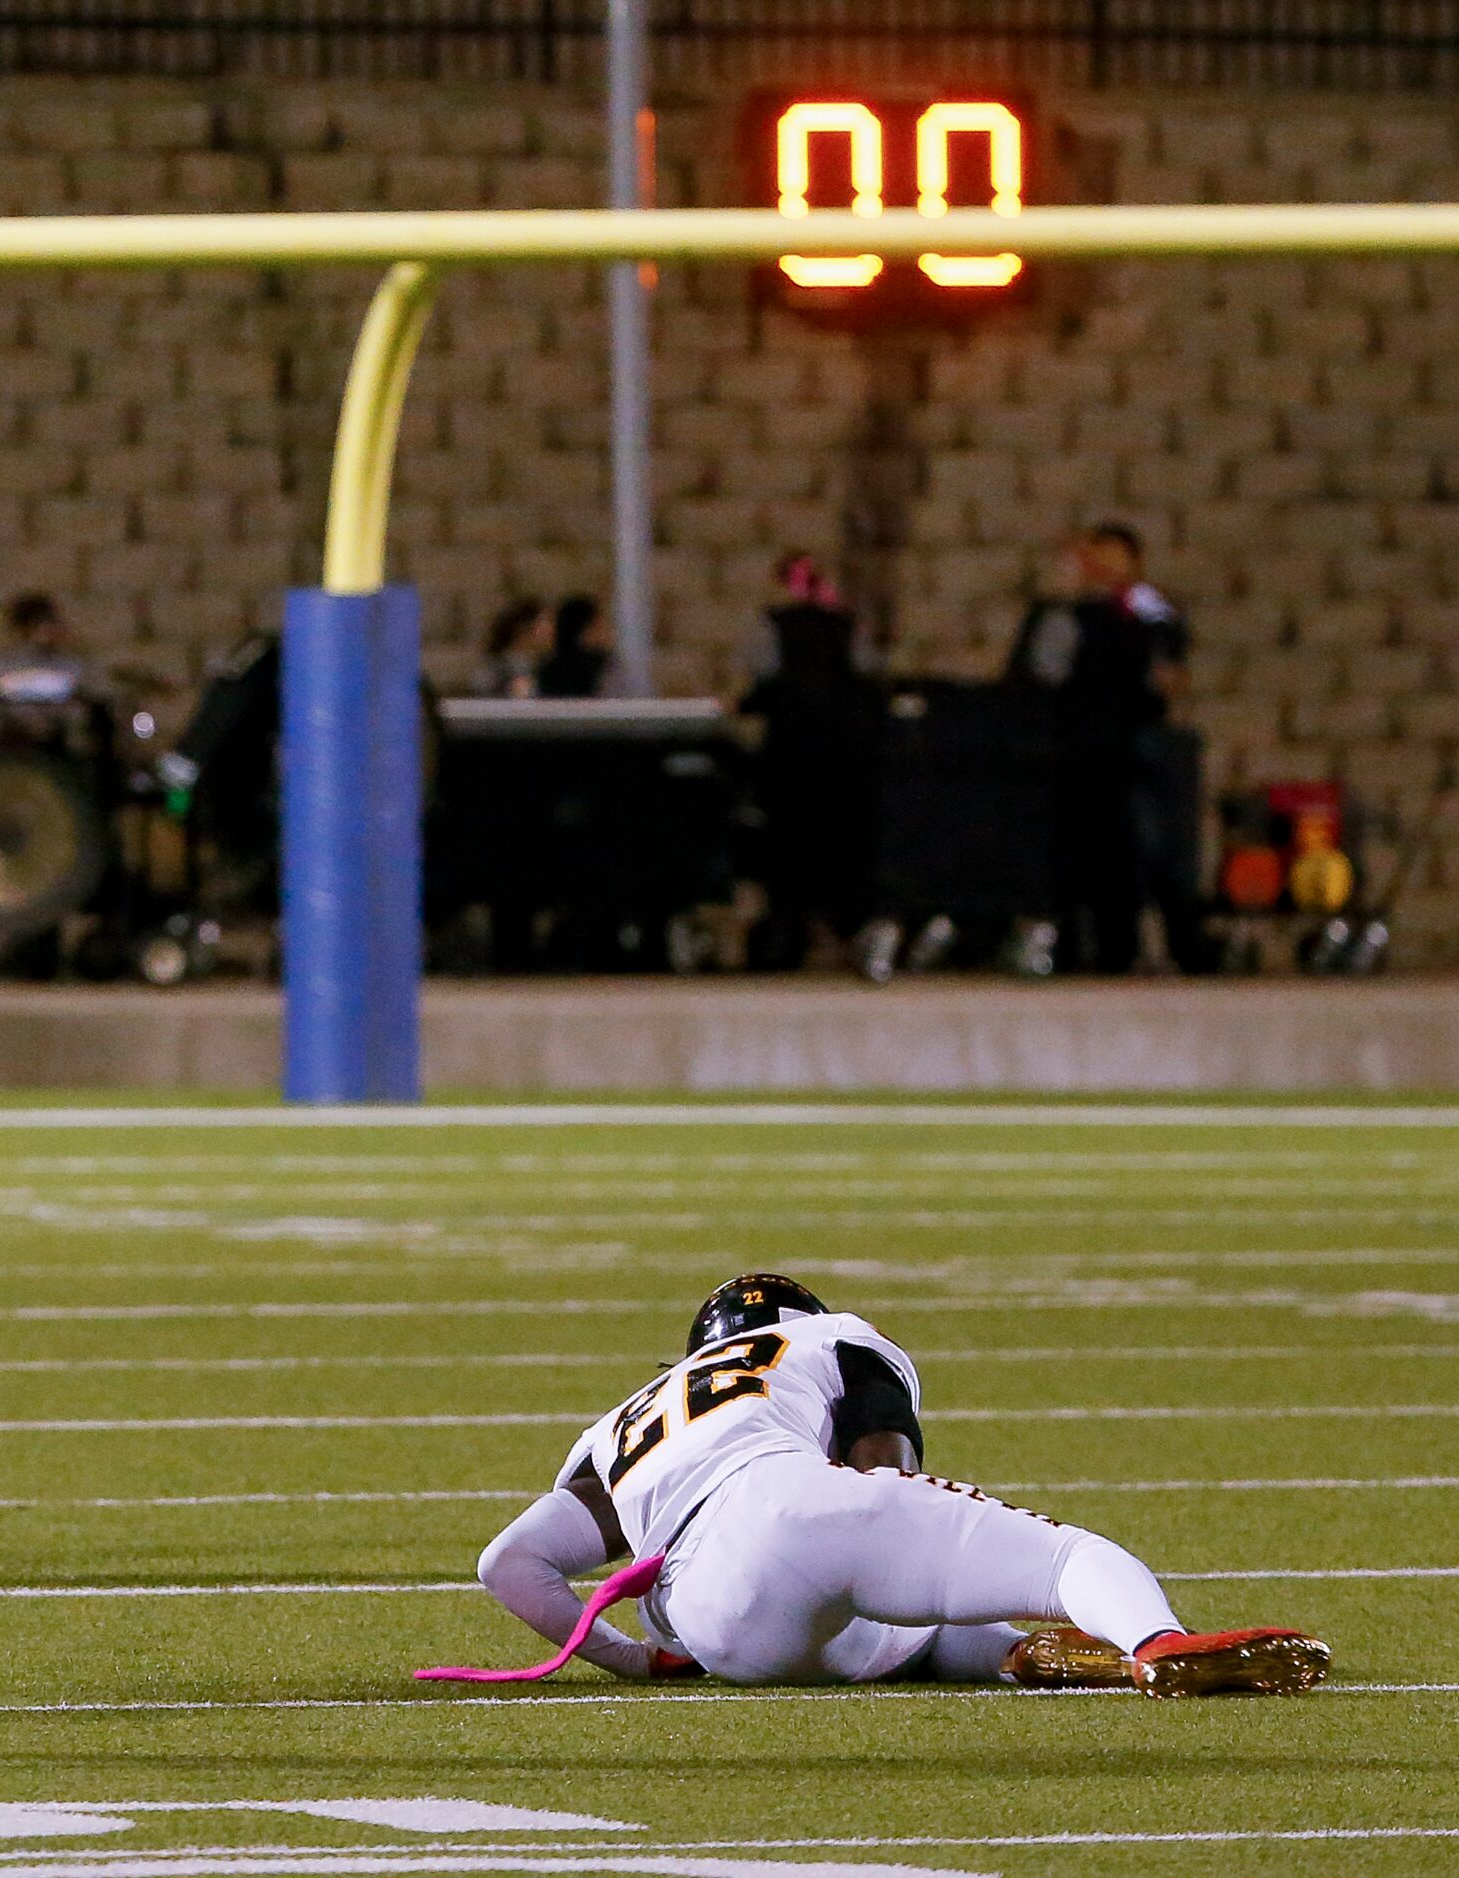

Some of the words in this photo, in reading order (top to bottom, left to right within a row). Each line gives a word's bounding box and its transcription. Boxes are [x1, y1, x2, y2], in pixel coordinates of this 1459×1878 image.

[776, 102, 1023, 287] 00
[742, 1290, 764, 1305] 22
[608, 1331, 792, 1495] 22
